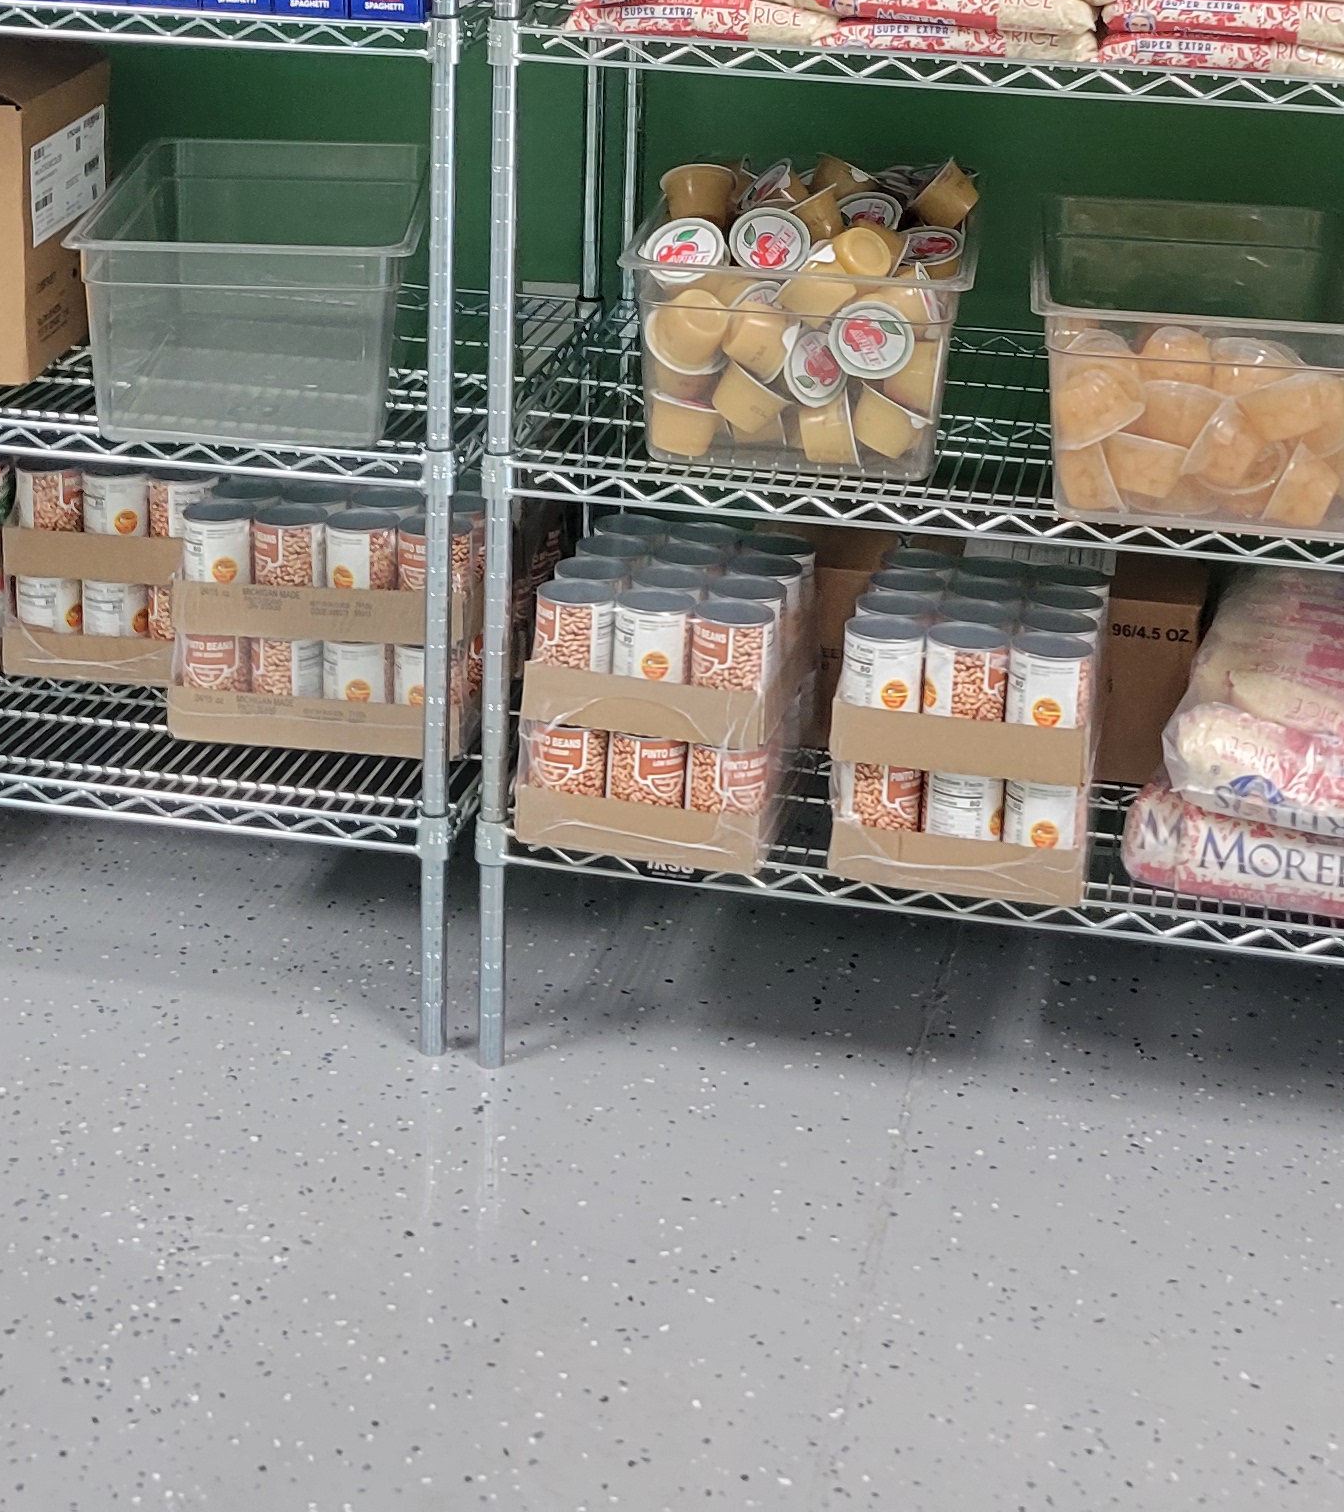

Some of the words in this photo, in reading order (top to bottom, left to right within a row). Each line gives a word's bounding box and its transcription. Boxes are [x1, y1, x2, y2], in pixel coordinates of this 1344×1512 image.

[290, 0, 330, 9] SPAGHETTI
[279, 590, 301, 600] MADE
[1112, 623, 1161, 640] 96/4.5
[1165, 628, 1193, 643] OZ.
[641, 747, 669, 759] PINTO
[969, 800, 981, 808] 80
